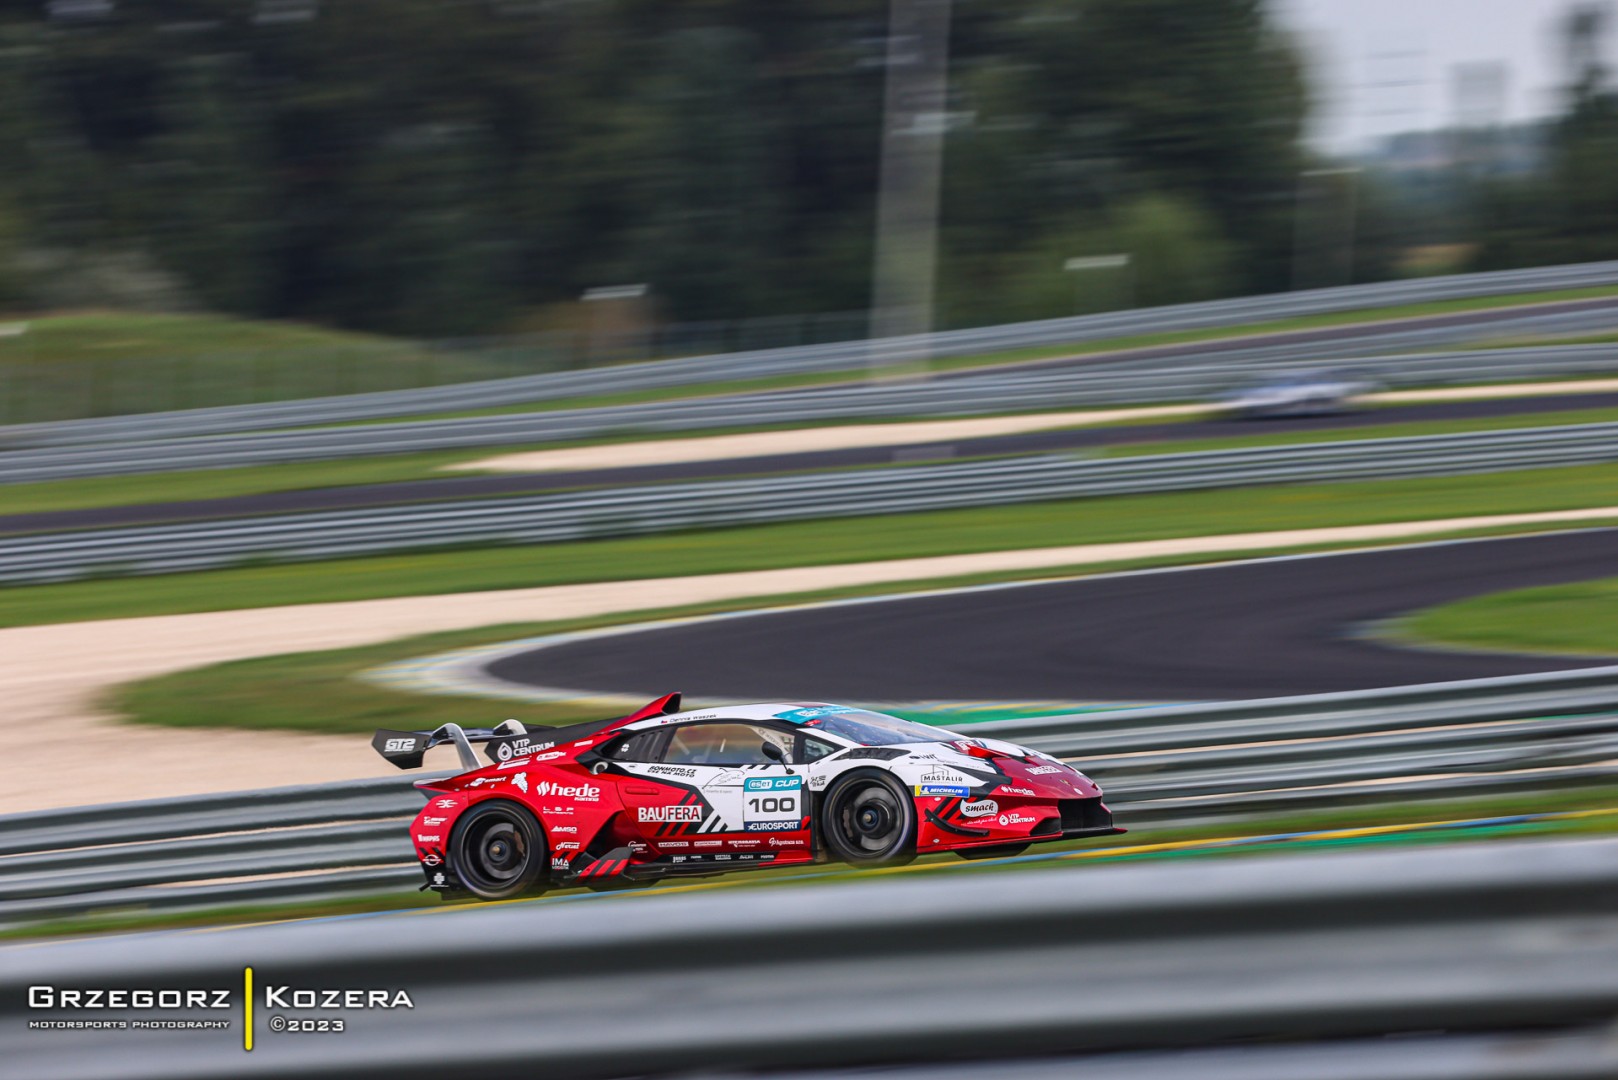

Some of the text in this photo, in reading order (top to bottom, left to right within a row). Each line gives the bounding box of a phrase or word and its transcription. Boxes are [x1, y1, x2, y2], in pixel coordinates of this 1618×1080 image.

[512, 738, 530, 748] VTP
[513, 741, 555, 756] CENTRUM
[775, 779, 799, 788] CUP
[550, 783, 600, 796] hede
[748, 797, 795, 813] 100
[965, 802, 994, 813] smack
[638, 806, 702, 821] BAUFERA
[750, 821, 798, 831] EUROSPORT
[552, 858, 569, 866] IMA
